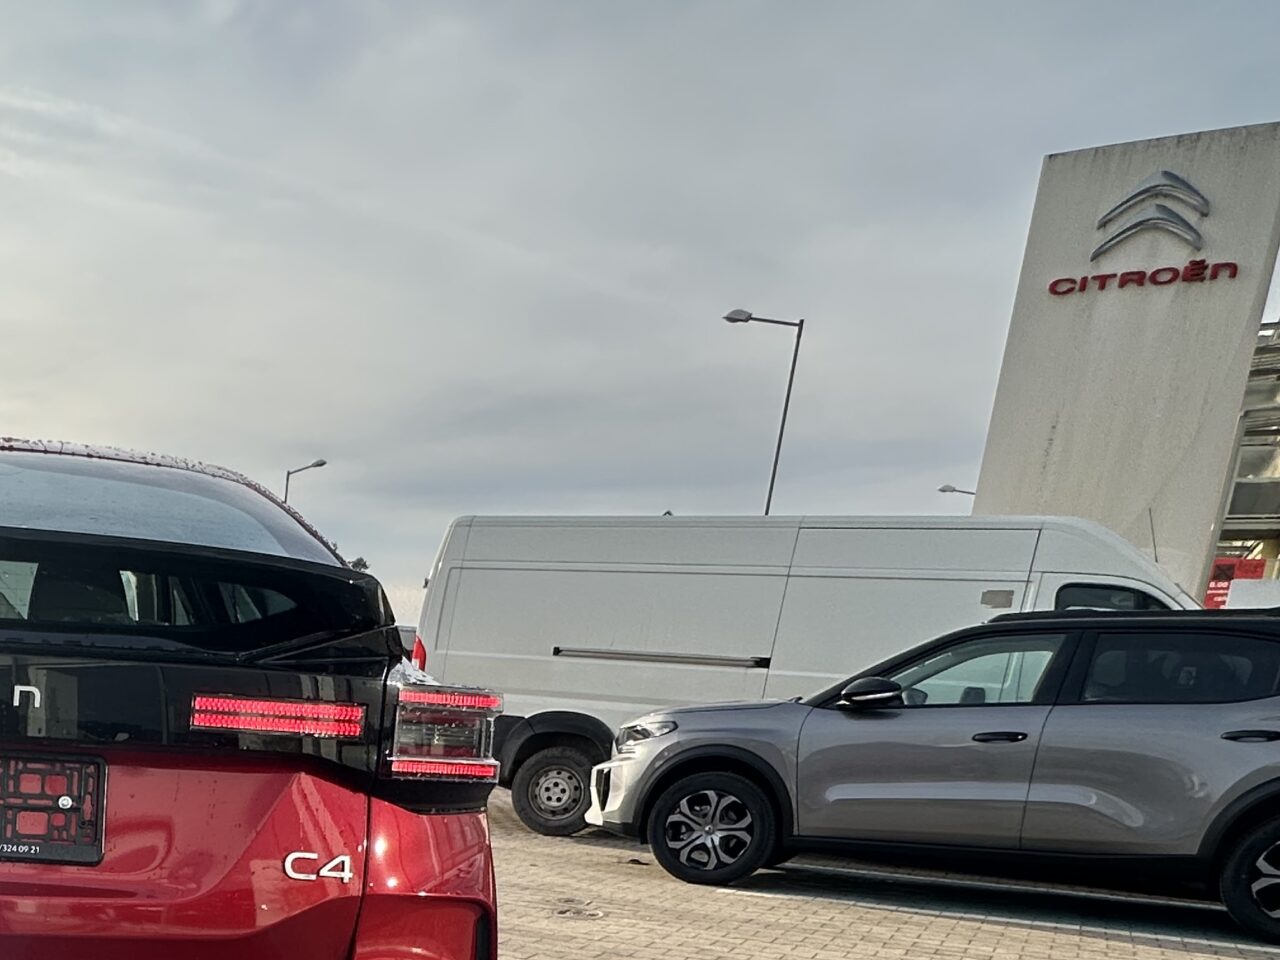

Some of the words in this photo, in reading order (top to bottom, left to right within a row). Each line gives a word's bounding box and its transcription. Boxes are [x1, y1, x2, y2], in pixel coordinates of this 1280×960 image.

[1048, 258, 1239, 296] CITROËN
[30, 845, 40, 854] 21
[283, 850, 354, 884] C4
